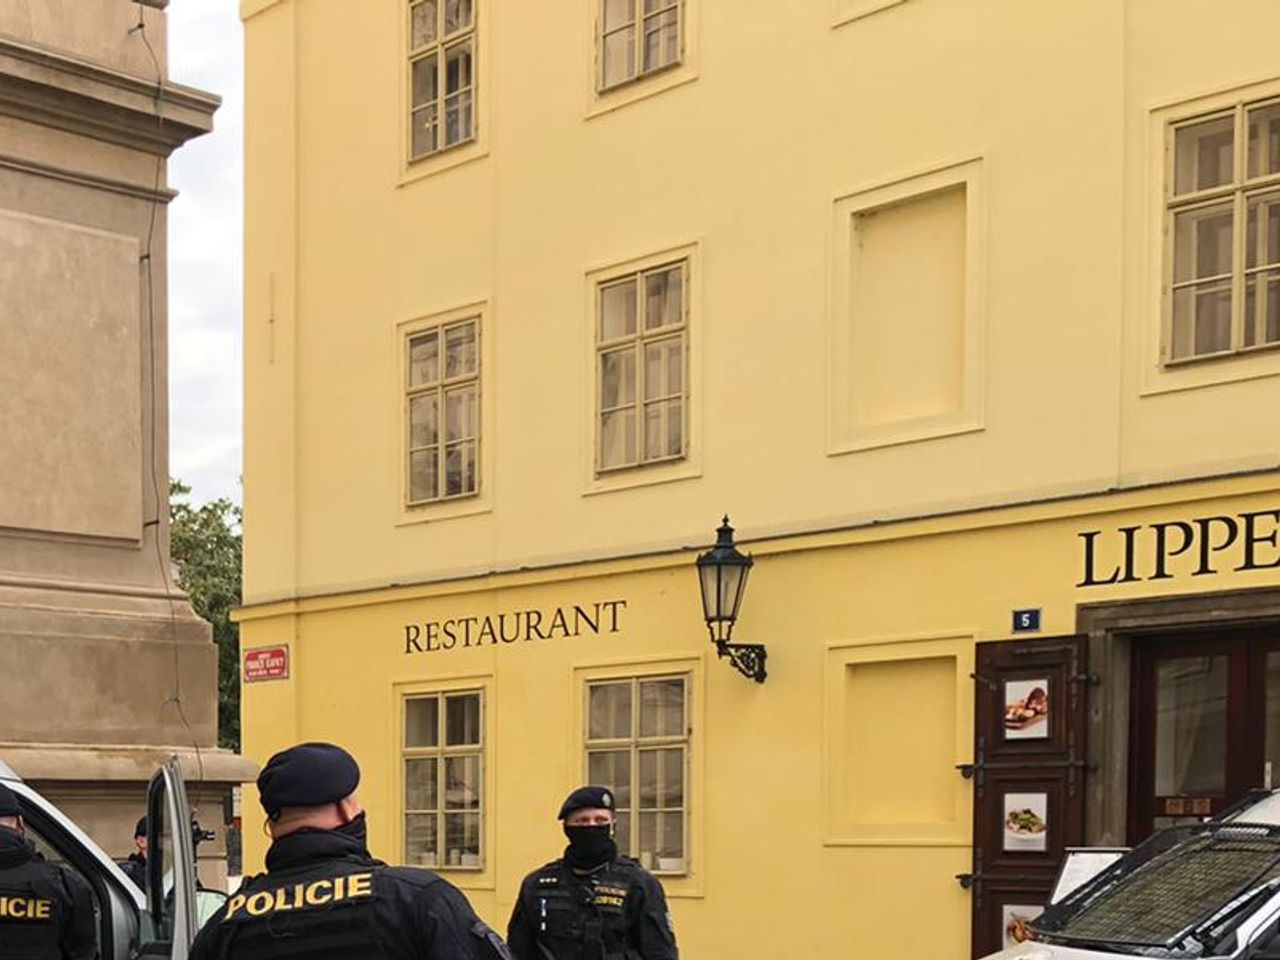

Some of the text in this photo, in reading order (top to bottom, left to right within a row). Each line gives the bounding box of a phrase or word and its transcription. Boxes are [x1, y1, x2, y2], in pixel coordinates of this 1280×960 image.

[1075, 509, 1280, 588] LIPPE
[404, 600, 627, 654] RESTAURANT
[1022, 614, 1030, 627] 5
[223, 873, 372, 921] POLICIE
